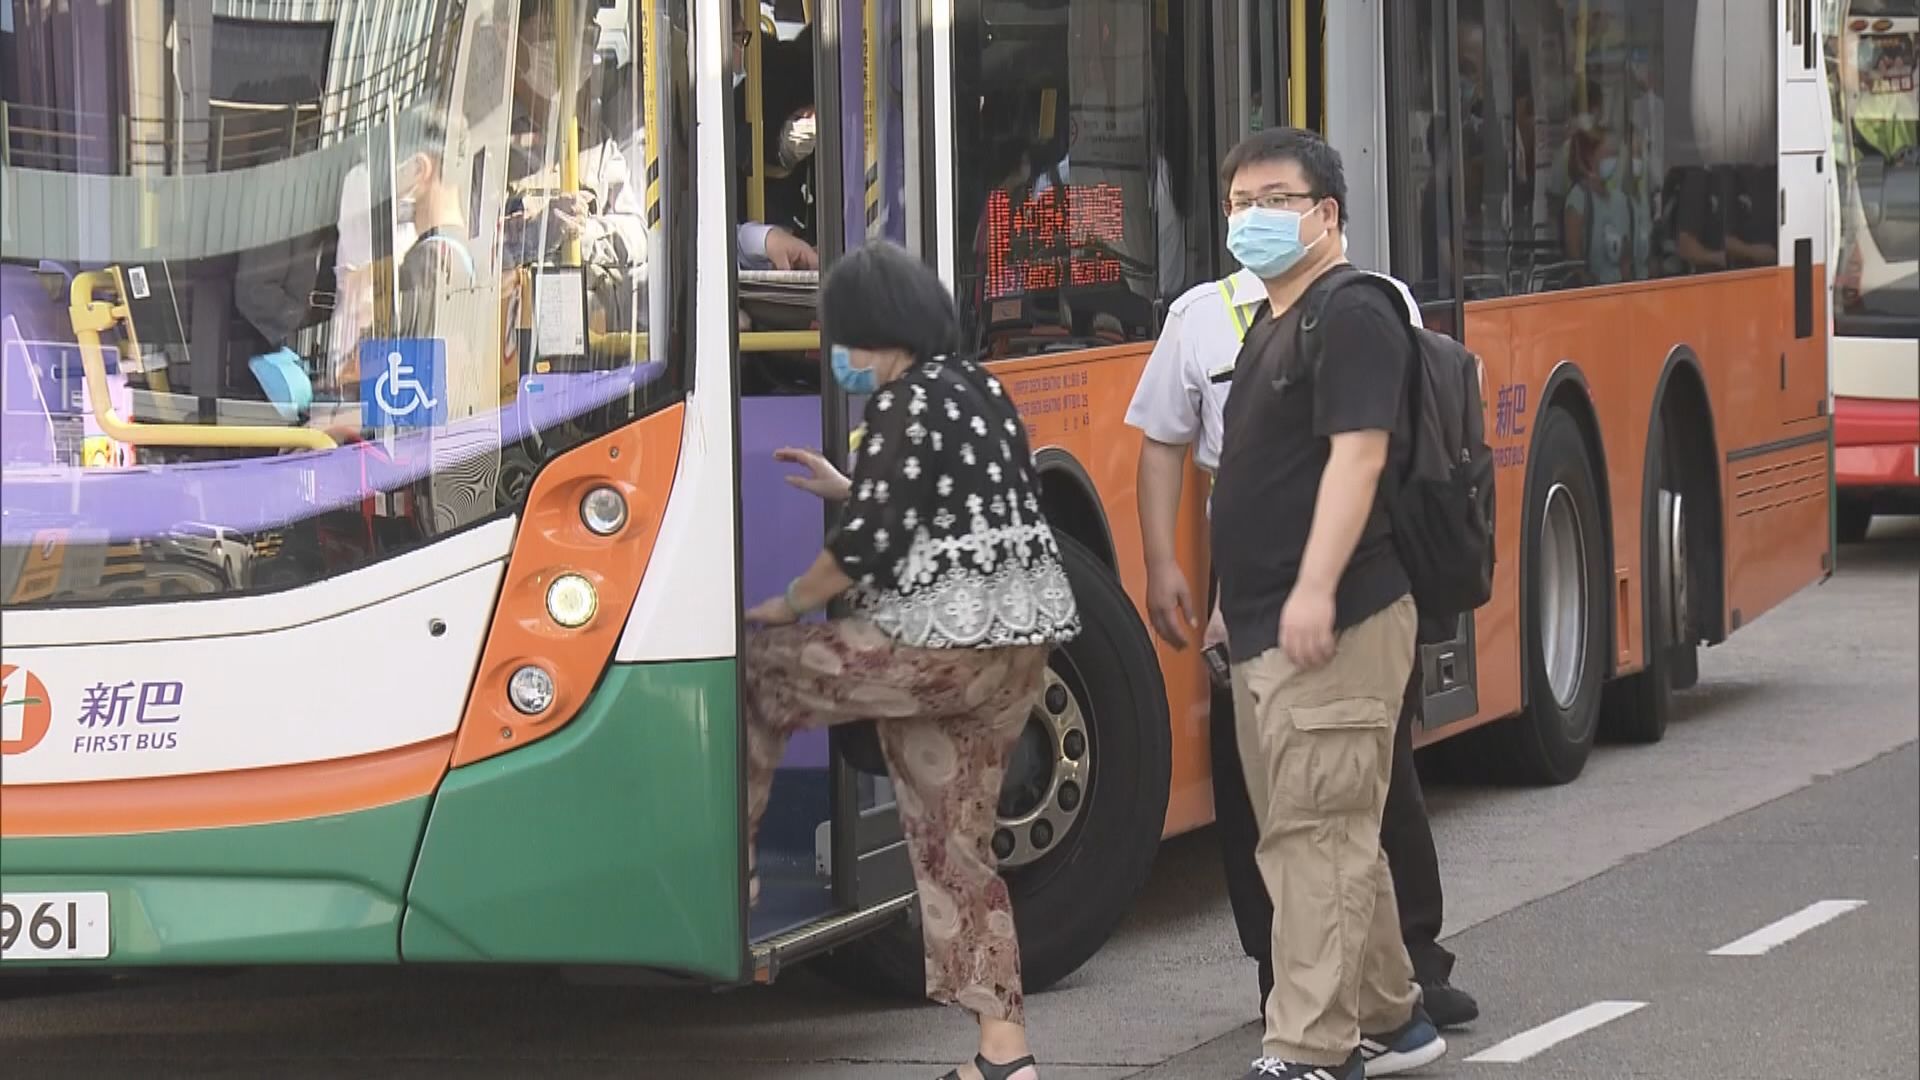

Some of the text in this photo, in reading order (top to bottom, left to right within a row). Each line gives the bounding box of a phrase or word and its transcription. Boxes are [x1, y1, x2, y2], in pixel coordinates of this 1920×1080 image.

[1496, 384, 1526, 437] 新巴
[77, 680, 184, 729] 新巴
[73, 731, 178, 753] FIRST BUS
[0, 901, 77, 950] 961
